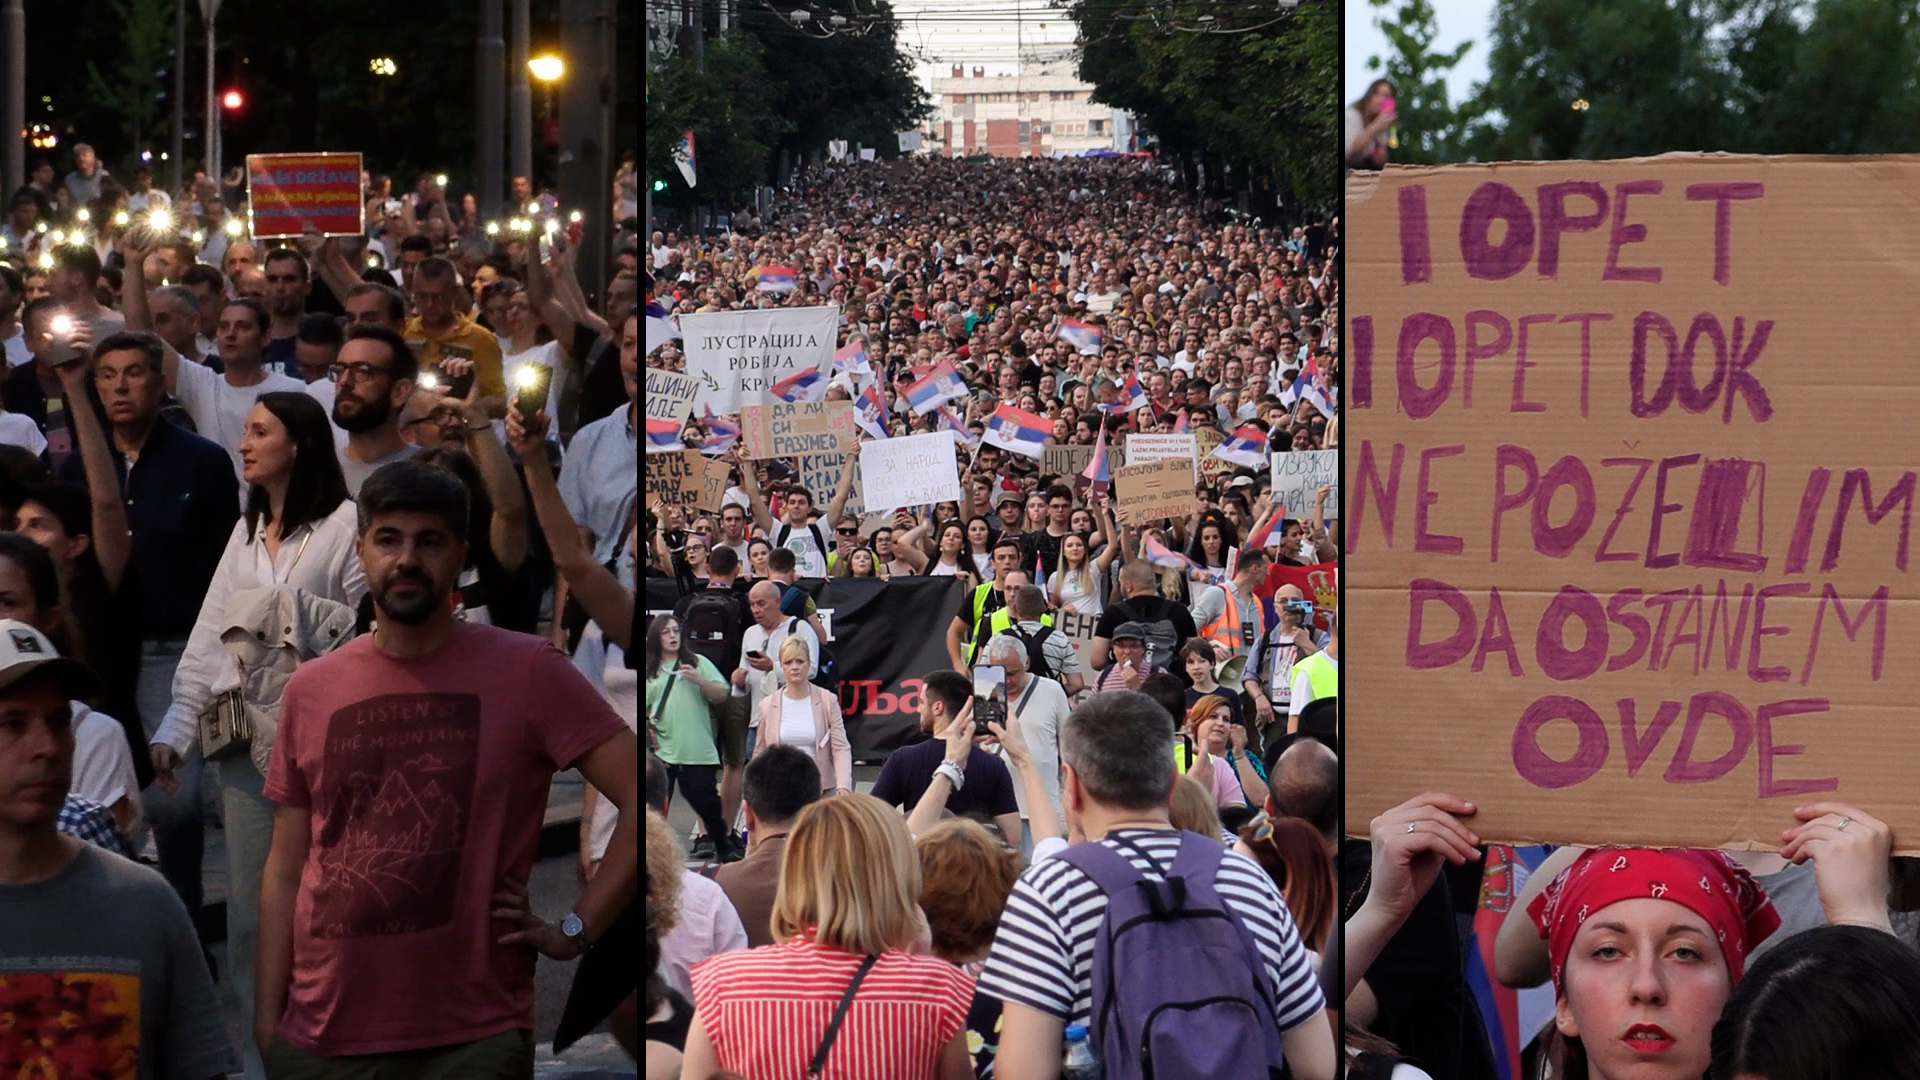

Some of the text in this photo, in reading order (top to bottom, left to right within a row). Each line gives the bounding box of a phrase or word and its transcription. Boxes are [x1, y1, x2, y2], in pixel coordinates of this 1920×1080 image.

[1398, 180, 1765, 286] I OPET
[701, 333, 818, 351] ЛУСТРАЦИЈА
[729, 355, 794, 371] РОБИЈА
[1350, 309, 1775, 424] I OPET DOK
[772, 403, 824, 419] ДА ЛИ
[772, 421, 791, 435] СИ
[774, 434, 838, 455] РАЗУМЕО
[884, 453, 942, 473] ЗА НАРОД
[1276, 450, 1335, 476] ИЗВУКО
[903, 490, 916, 505] ЗА
[922, 483, 953, 502] ВЛАСТ
[1345, 440, 1465, 556] NE
[1405, 578, 1890, 687] DA OSTANEM
[357, 701, 430, 725] LISTEN
[331, 733, 362, 753] THE
[1511, 691, 1839, 799] OVDE
